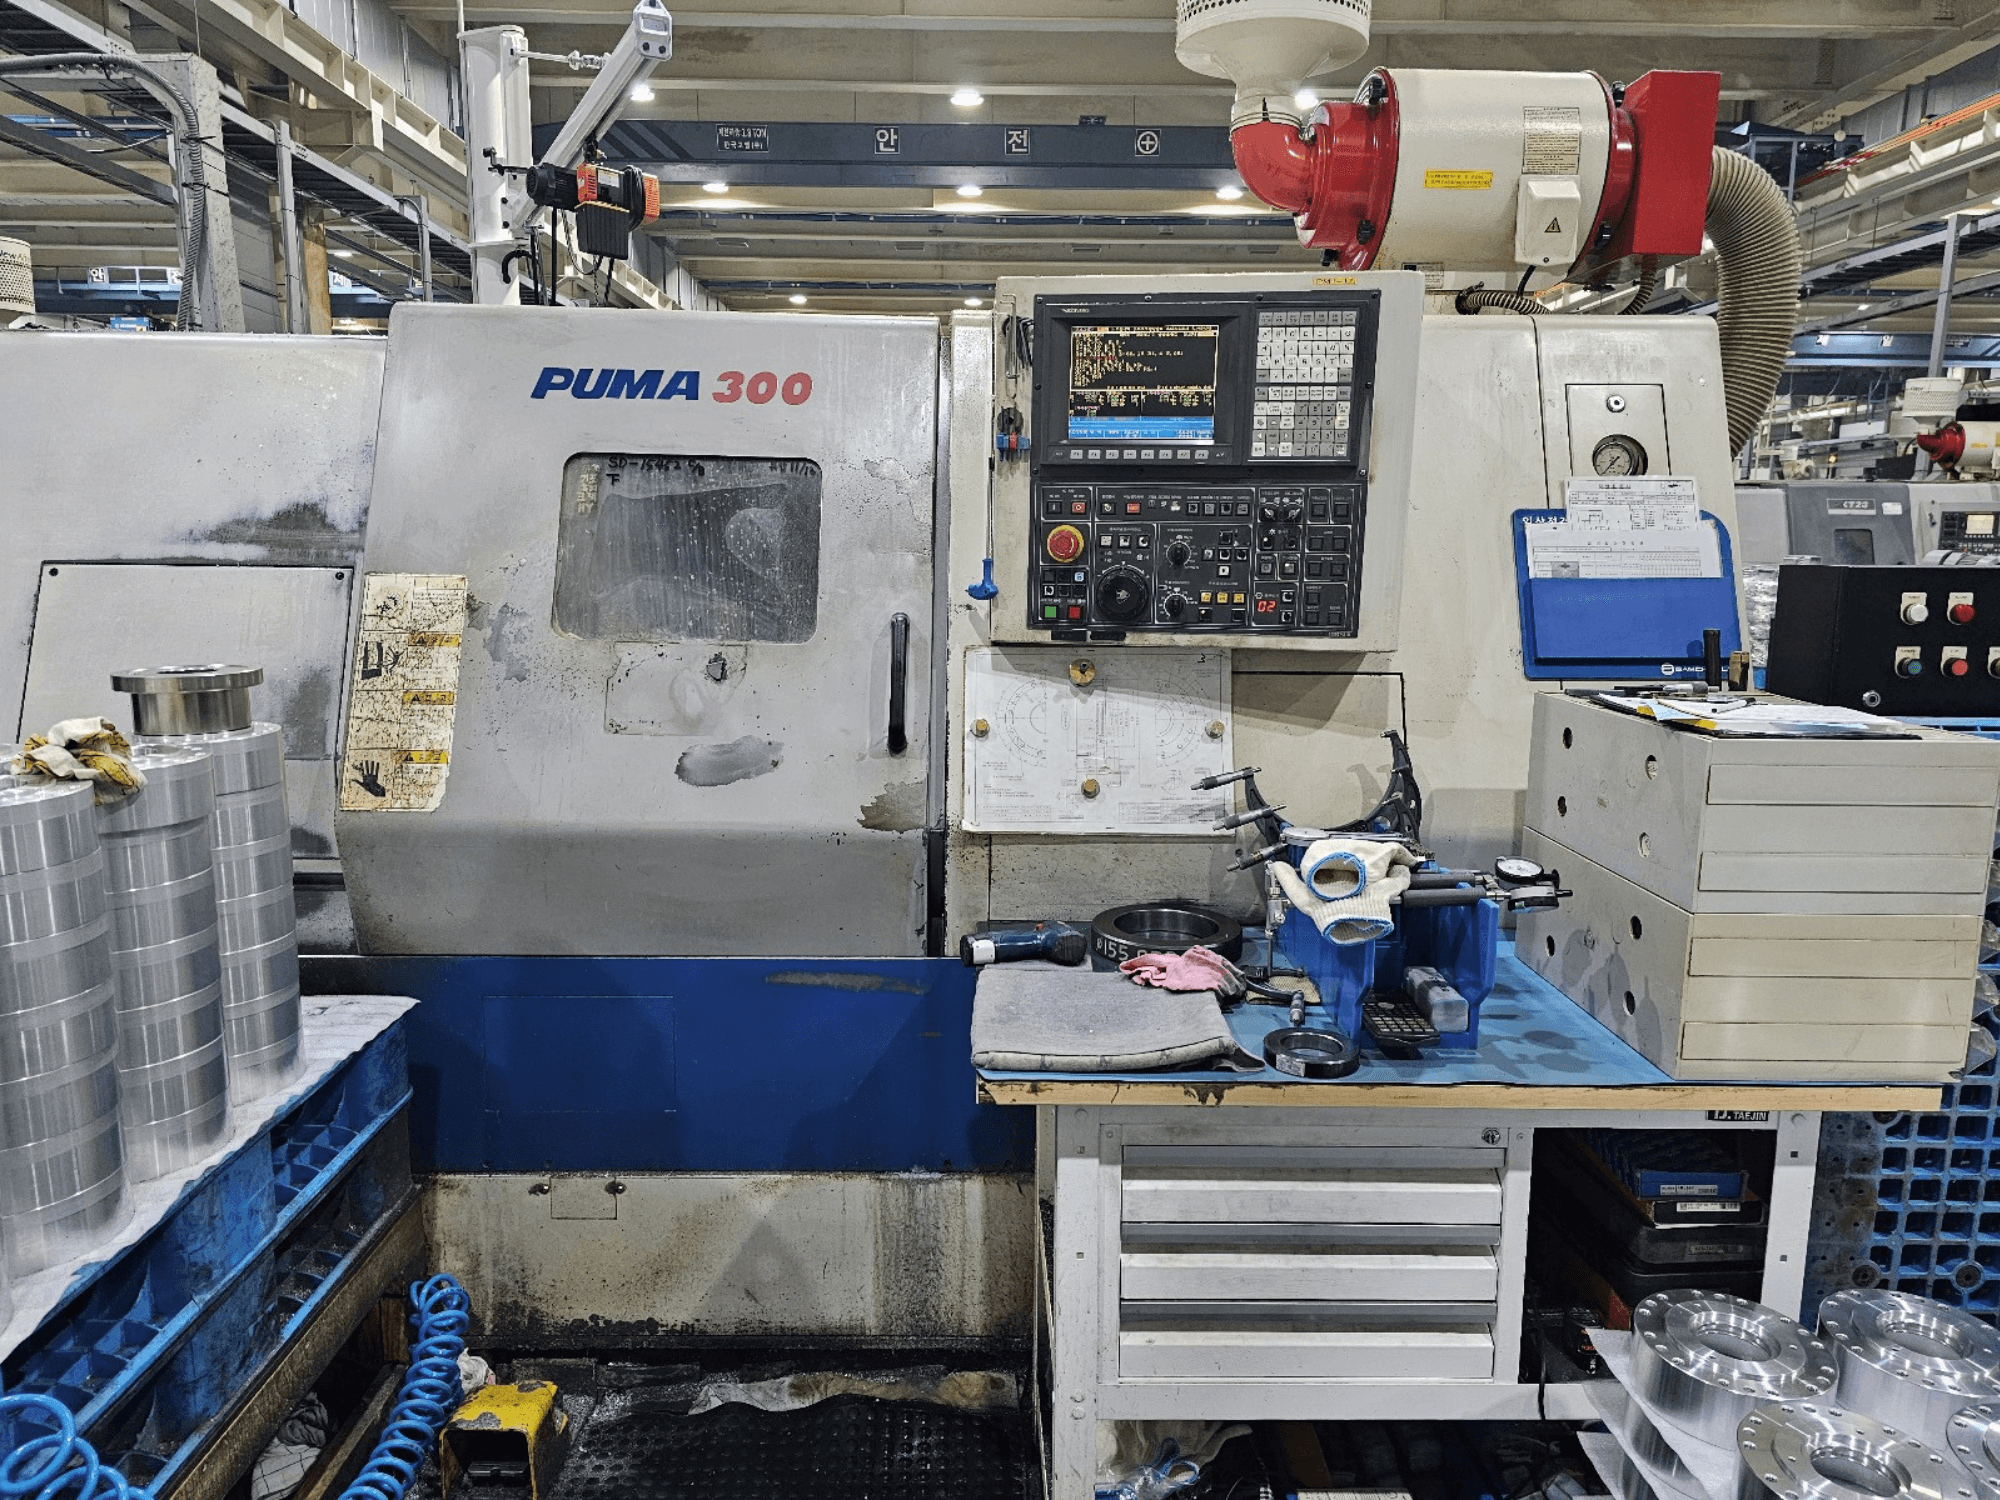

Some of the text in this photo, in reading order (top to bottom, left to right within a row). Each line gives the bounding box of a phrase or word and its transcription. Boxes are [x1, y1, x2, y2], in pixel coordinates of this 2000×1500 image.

[875, 128, 898, 153] 안
[1006, 129, 1029, 153] 전
[89, 268, 104, 282] 안
[530, 366, 814, 406] PUMA 300
[1257, 600, 1277, 613] 02
[1733, 1112, 1766, 1120] TAEJIN
